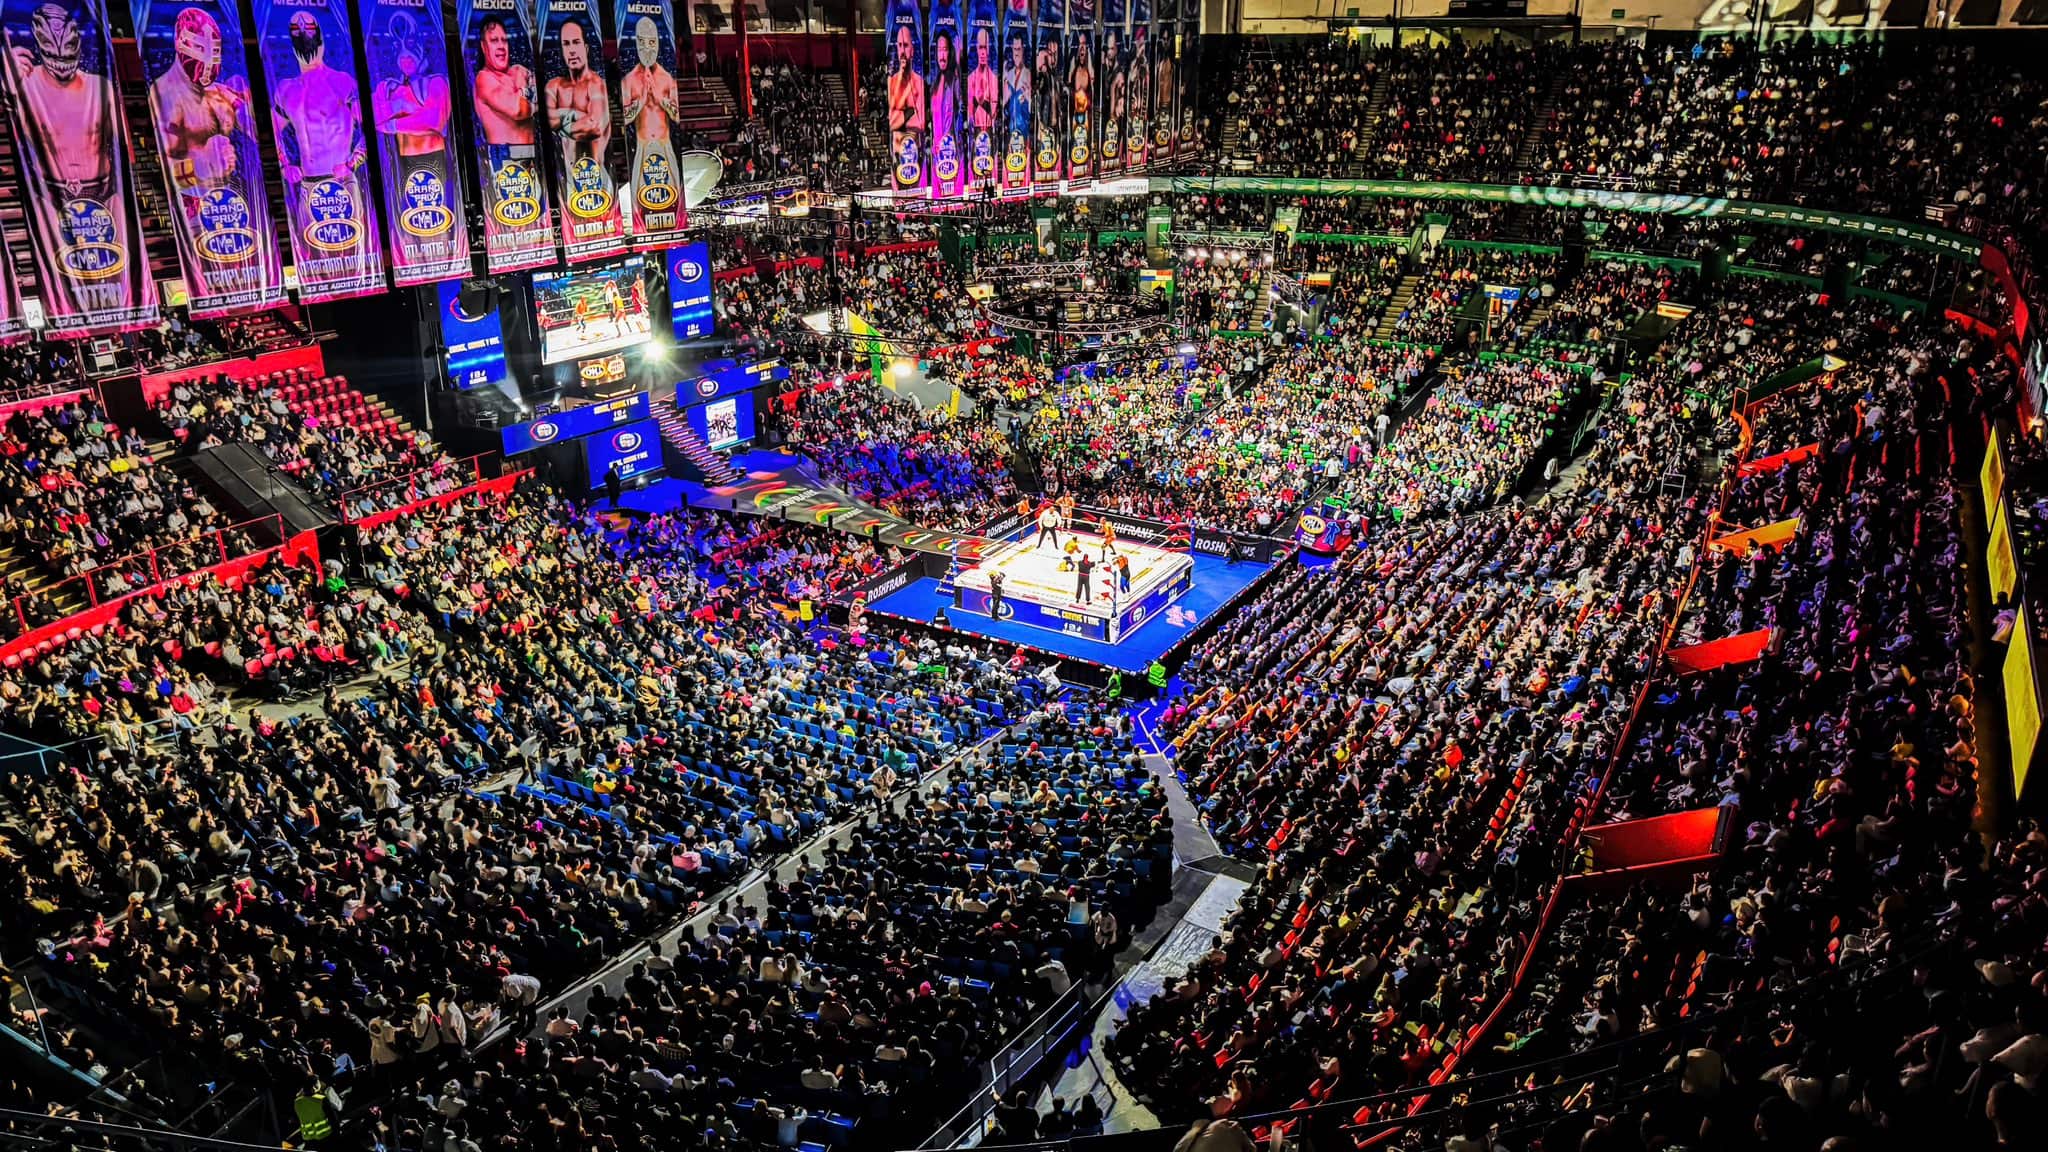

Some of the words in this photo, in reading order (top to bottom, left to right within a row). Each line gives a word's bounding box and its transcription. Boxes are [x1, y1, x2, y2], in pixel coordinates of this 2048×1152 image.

[311, 194, 350, 206] GRAND
[202, 202, 244, 216] GRAND
[1110, 522, 1154, 539] SHFRANS
[867, 571, 908, 603] ROSHFRANS
